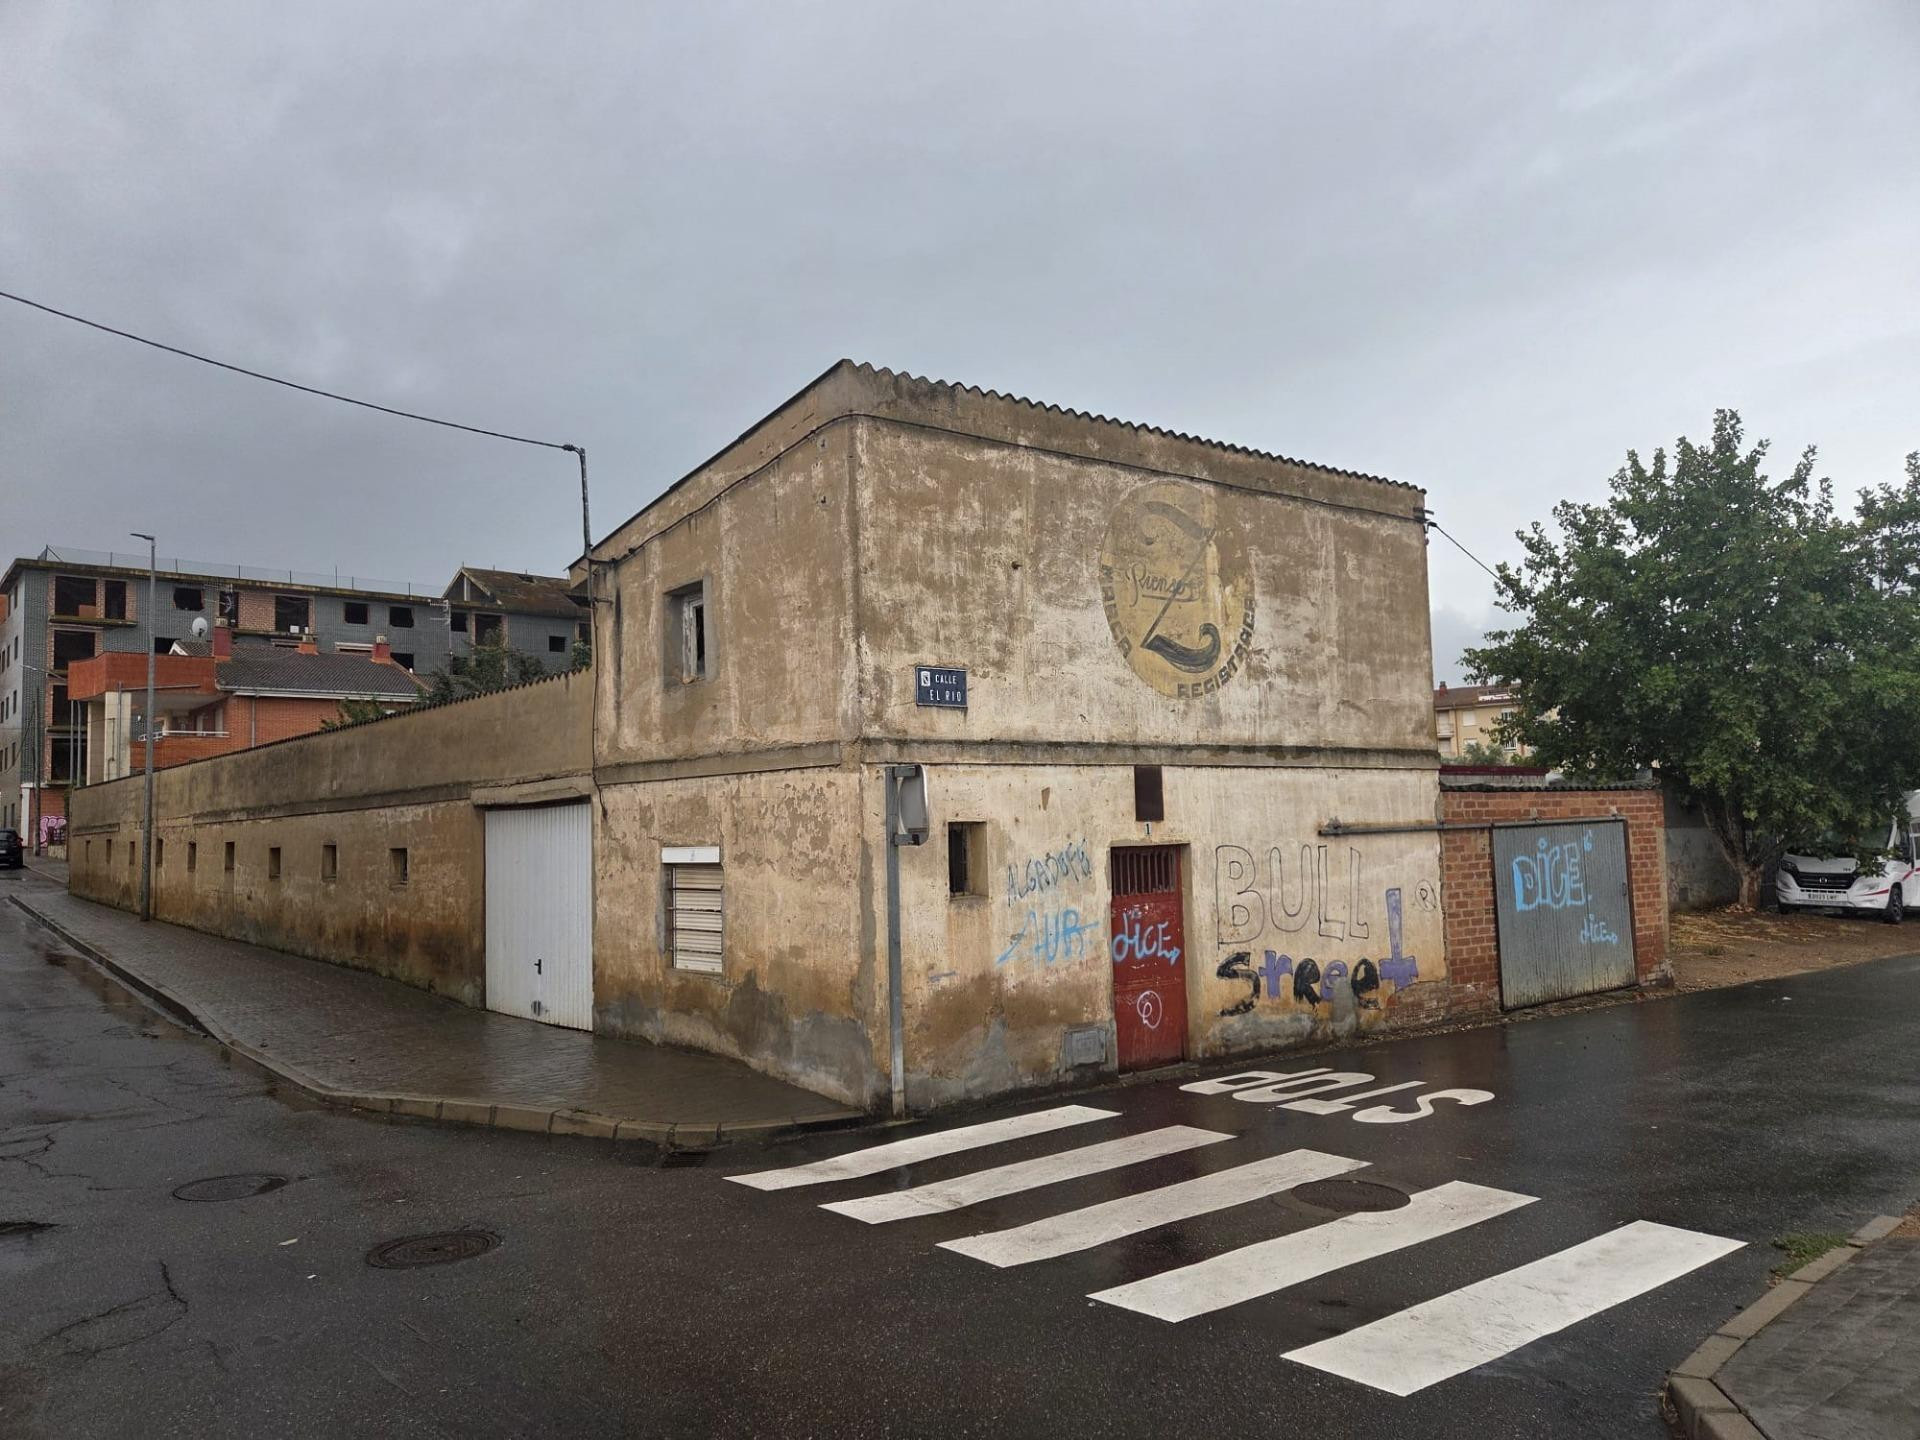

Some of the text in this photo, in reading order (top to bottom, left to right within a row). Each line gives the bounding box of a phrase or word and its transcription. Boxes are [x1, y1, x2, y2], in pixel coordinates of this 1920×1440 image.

[935, 674, 957, 685] CALLE
[930, 689, 962, 702] EL RIO
[1215, 844, 1370, 950] BULL
